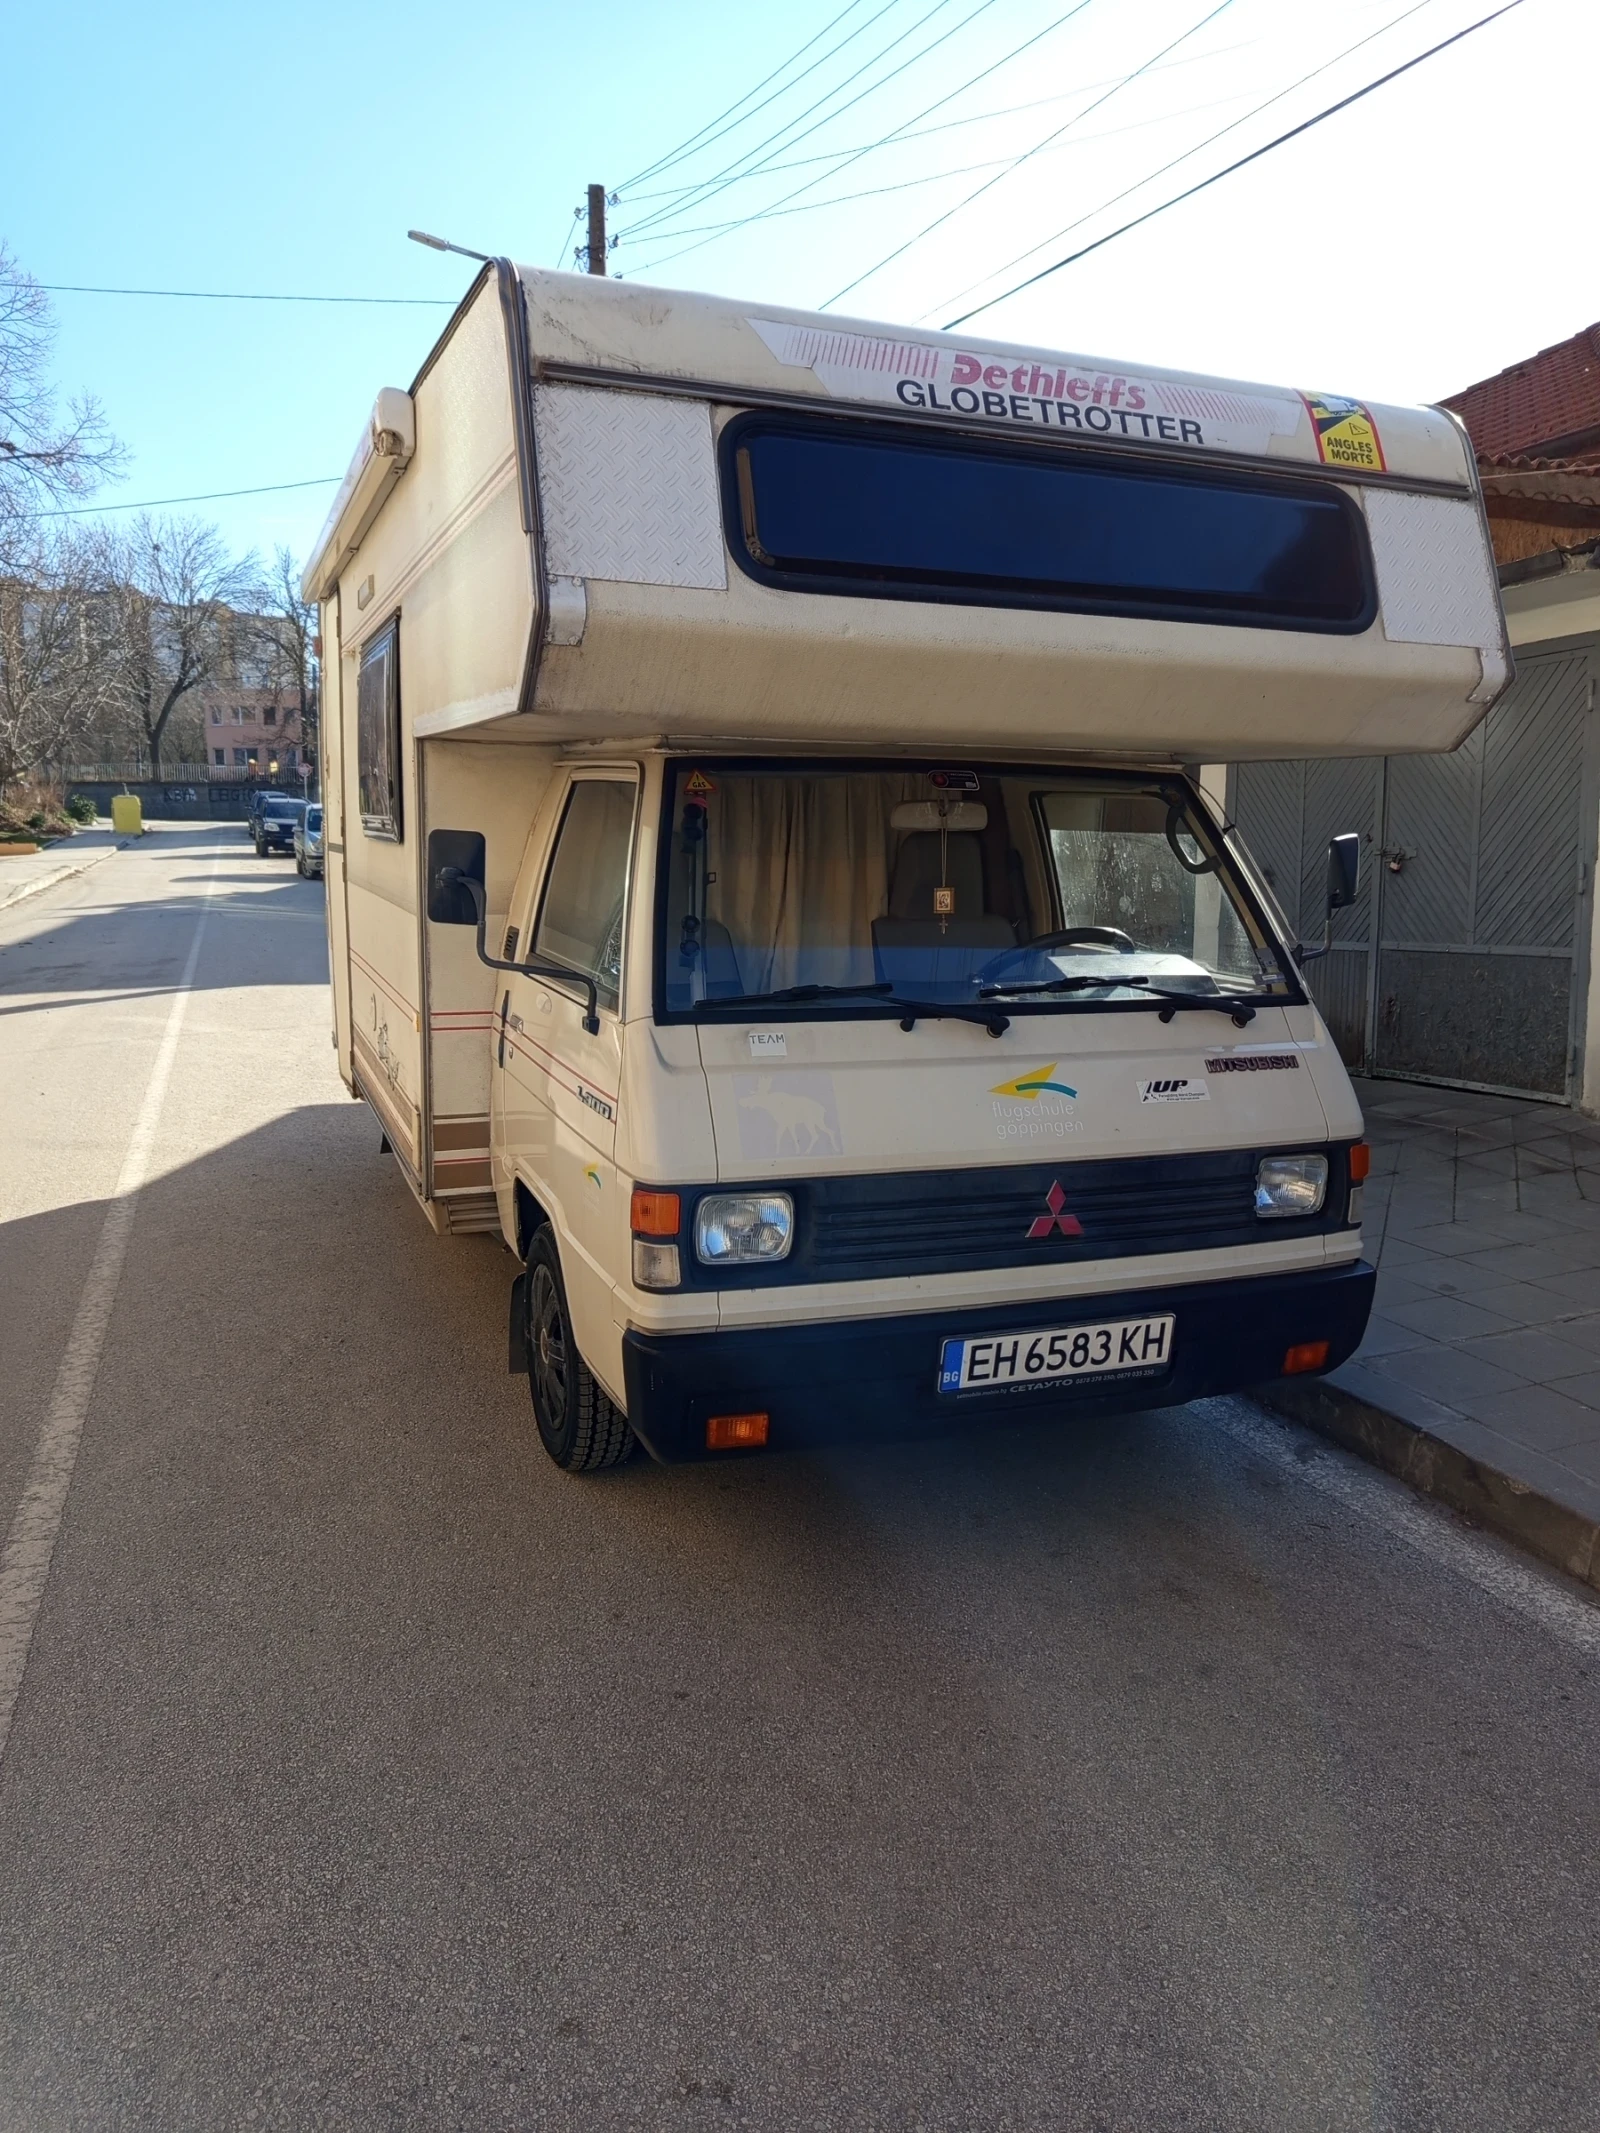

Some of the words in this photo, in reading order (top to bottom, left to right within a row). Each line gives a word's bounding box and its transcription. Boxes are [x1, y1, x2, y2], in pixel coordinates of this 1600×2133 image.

[950, 353, 1146, 411] Dethleffs
[896, 380, 1205, 445] GLOBETROTTER
[1326, 436, 1373, 454] ANGLES
[1331, 449, 1374, 465] MORTS
[749, 1034, 785, 1044] TEAM
[1204, 1055, 1299, 1074] MITSUBISHI
[992, 1099, 1075, 1121] flugschule
[996, 1118, 1084, 1140] göppingen
[943, 1371, 960, 1383] BG
